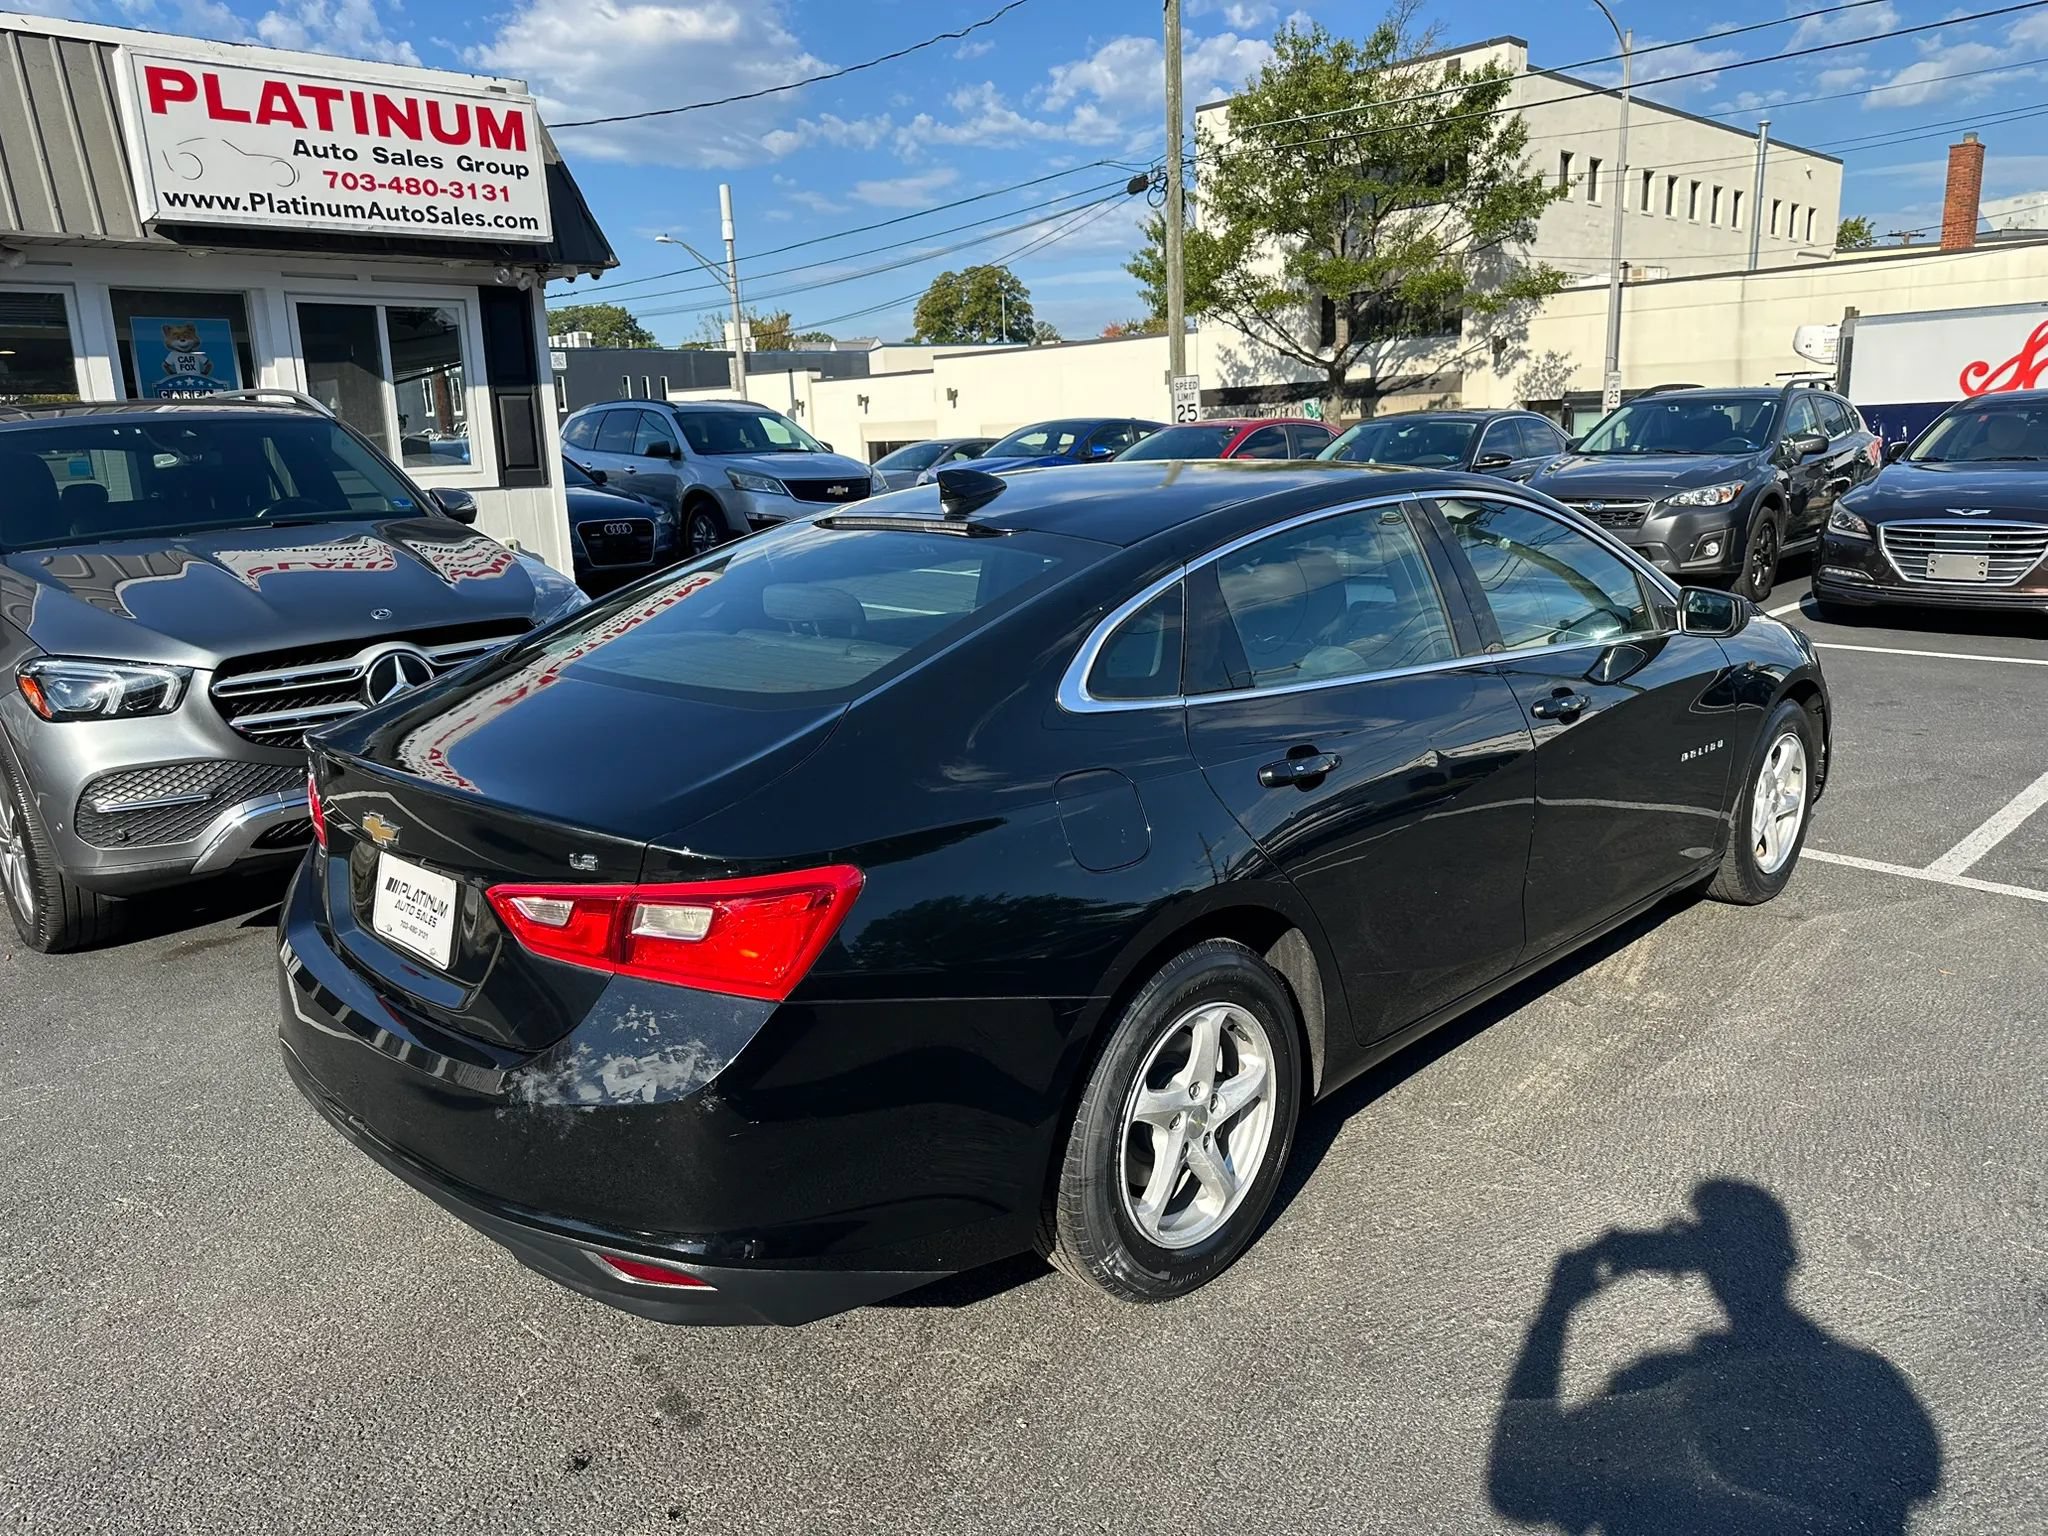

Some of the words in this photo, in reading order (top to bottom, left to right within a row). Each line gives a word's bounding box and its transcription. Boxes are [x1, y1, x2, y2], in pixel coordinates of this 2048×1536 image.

[144, 65, 527, 152] PLATINUM
[293, 139, 359, 162] Auto
[372, 146, 444, 170] Sales
[456, 155, 530, 180] Group
[322, 170, 510, 202] 703-480-3131
[162, 190, 540, 231] www.PlatinumAutoSales.com
[177, 356, 196, 364] CAR
[179, 363, 197, 371] FOX
[1175, 381, 1198, 391] SPEED
[1177, 392, 1196, 402] LIMIT
[1609, 390, 1619, 403] 25
[1176, 403, 1198, 423] 25
[569, 853, 599, 871] LS
[398, 881, 449, 919] PLATINUM
[394, 899, 416, 916] AUTO
[415, 909, 438, 928] SALES
